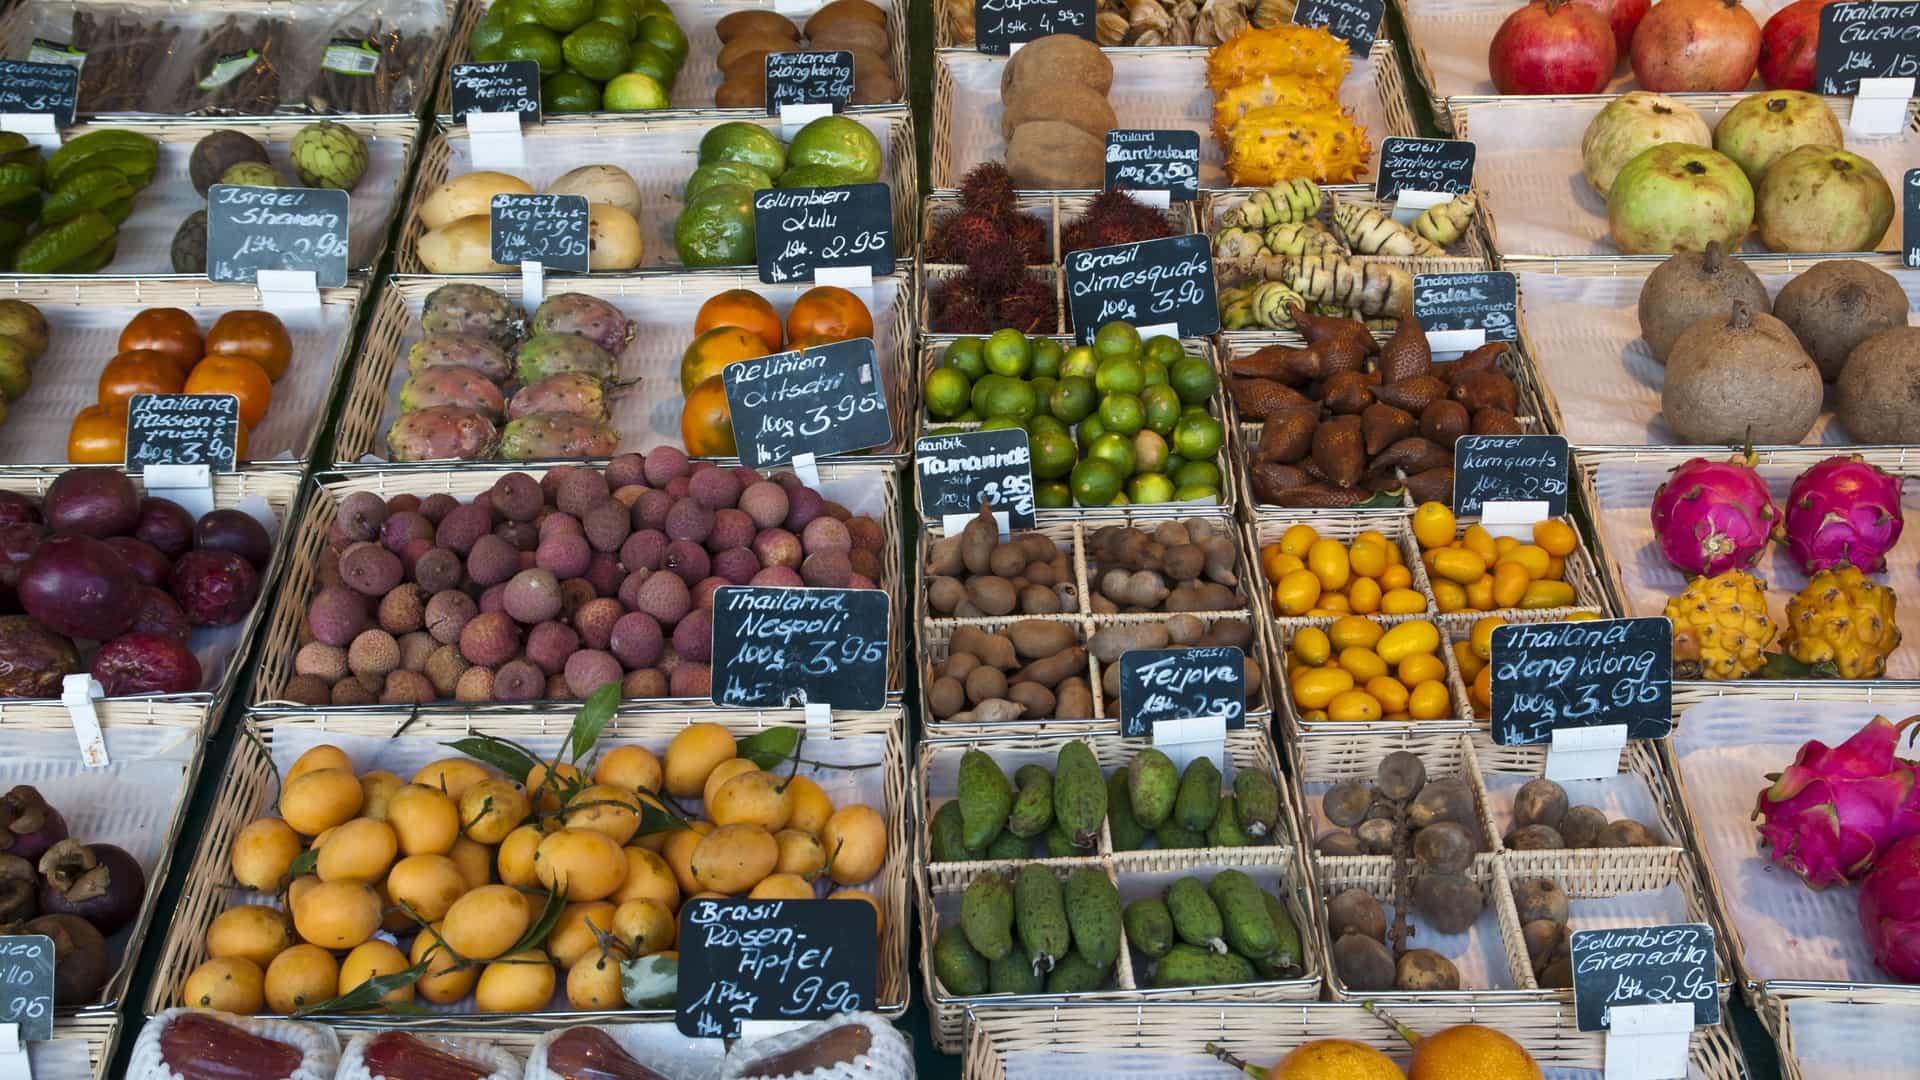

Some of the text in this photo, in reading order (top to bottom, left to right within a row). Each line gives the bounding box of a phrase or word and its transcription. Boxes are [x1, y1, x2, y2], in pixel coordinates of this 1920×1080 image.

[1832, 2, 1919, 23] Thailand
[1106, 131, 1155, 143] Thailand
[218, 187, 306, 206] Israel
[821, 230, 889, 259] 2.95
[1074, 244, 1140, 272] Brasil
[1073, 252, 1209, 297] Limesquats
[1150, 280, 1206, 314] 3.90
[754, 414, 795, 440] 100g
[1465, 436, 1524, 450] Israel
[728, 588, 849, 613] Thailand
[735, 611, 850, 645] Nespoli
[1506, 620, 1635, 649] Thailand
[725, 635, 888, 676] 100g 3.95
[1503, 677, 1670, 721] 100g 3.95
[690, 900, 784, 924] Brasil
[779, 975, 860, 1014] 9.90
